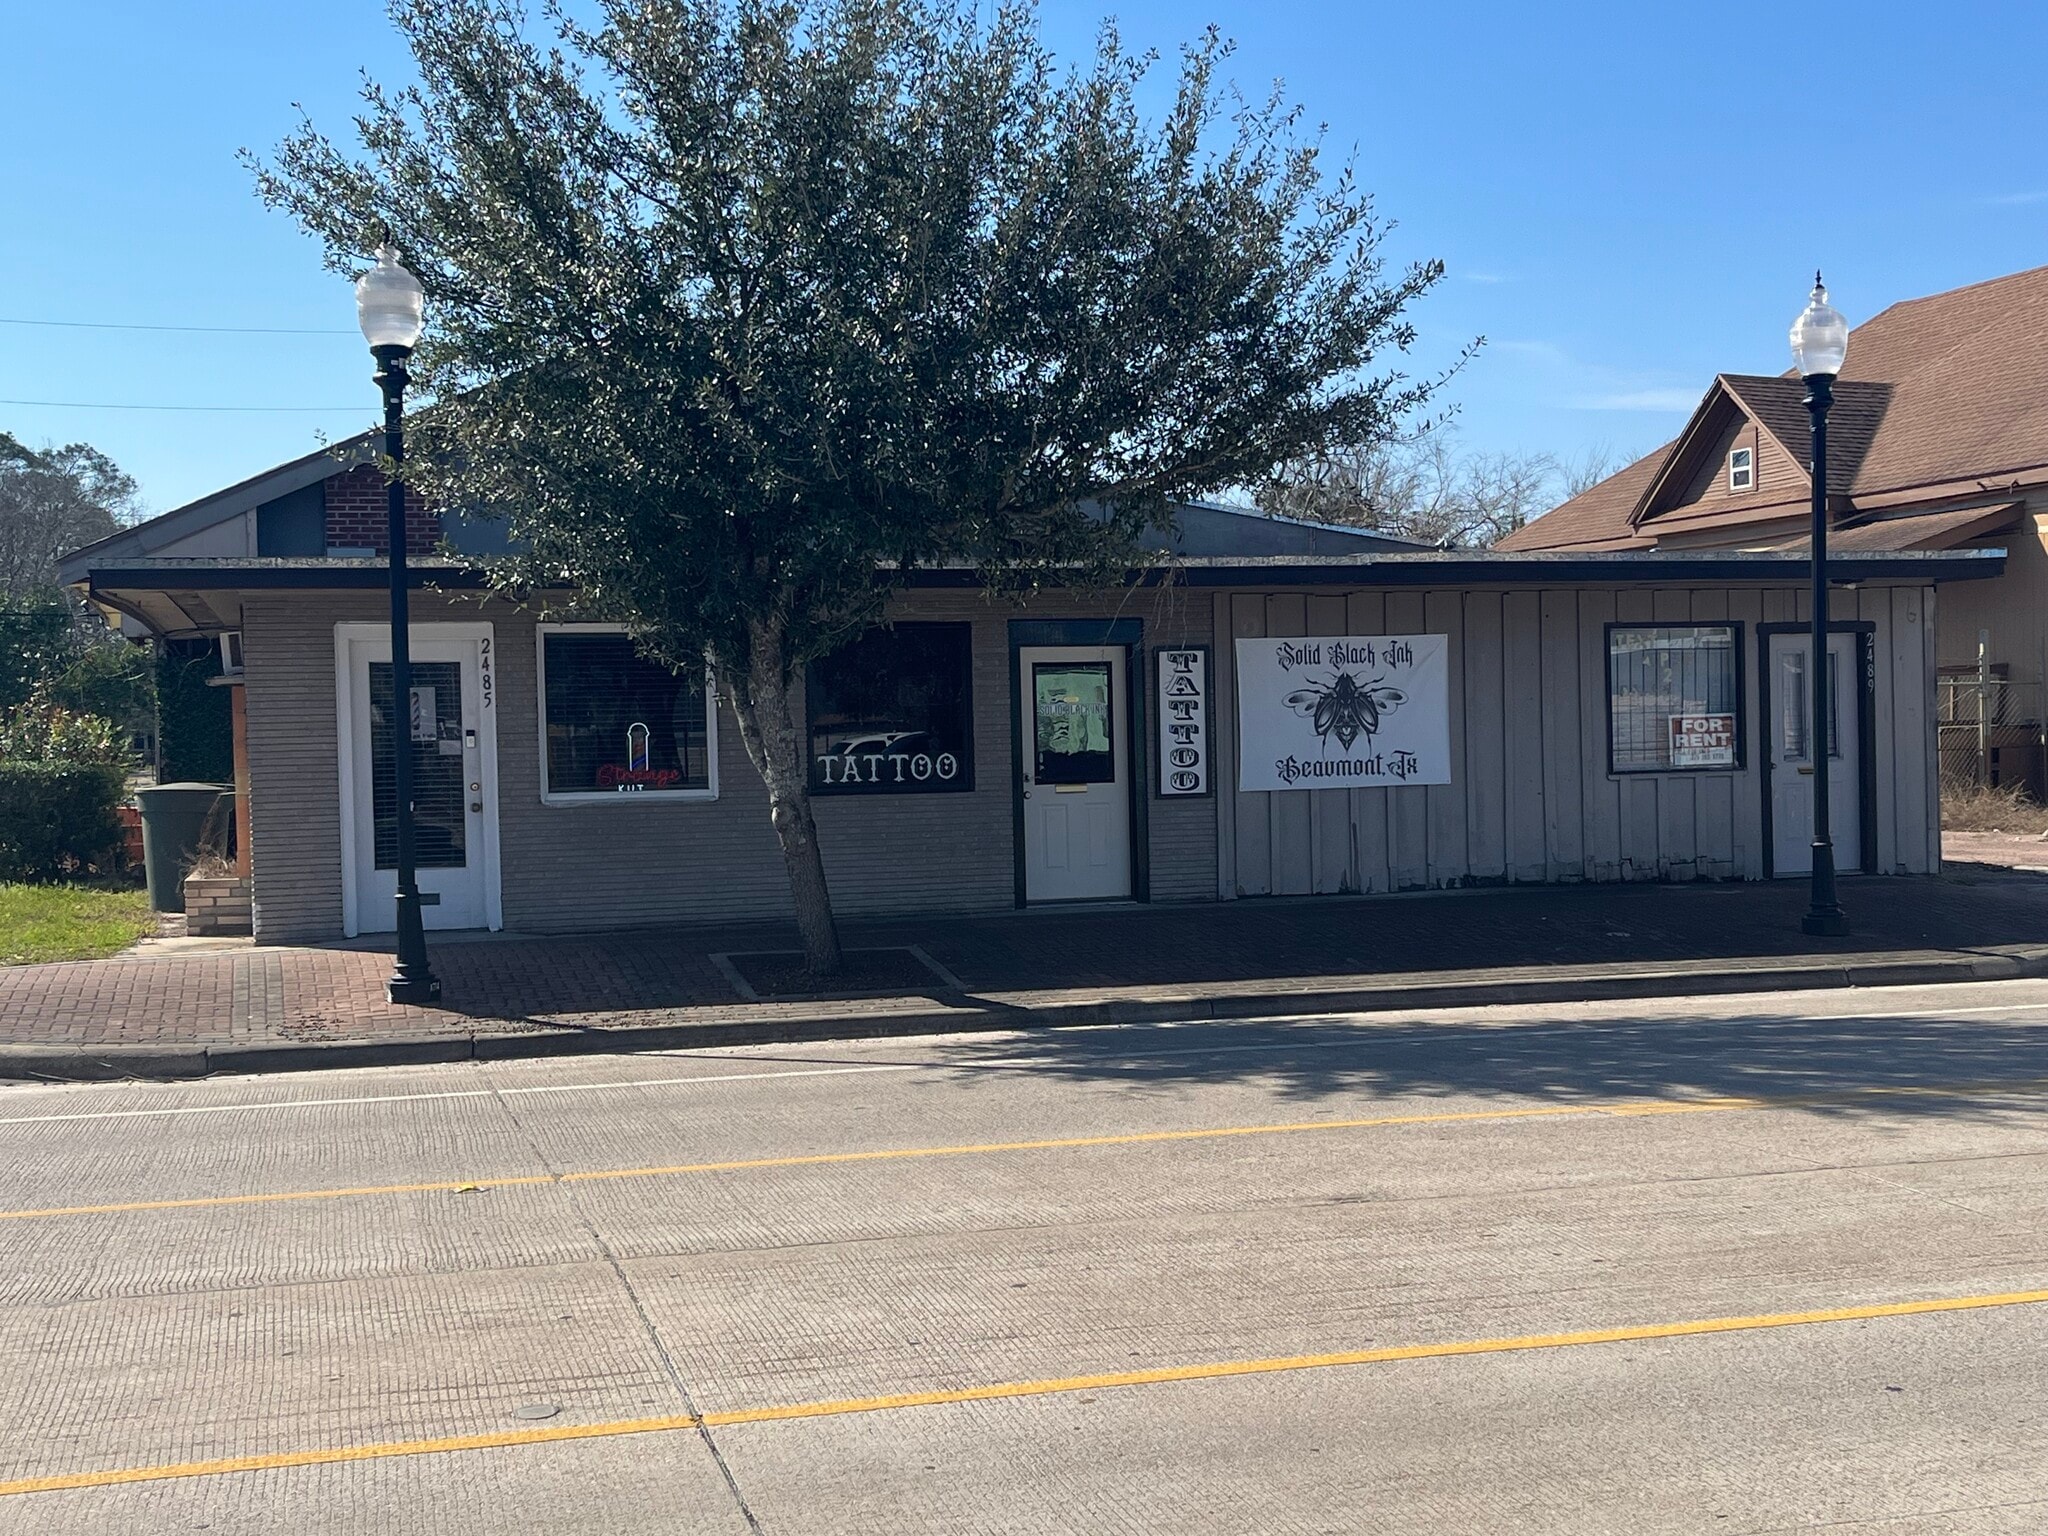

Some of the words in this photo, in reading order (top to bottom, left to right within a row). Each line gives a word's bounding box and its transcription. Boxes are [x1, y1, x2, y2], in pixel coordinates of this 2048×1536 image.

[1276, 641, 1321, 672] Solid
[1327, 641, 1376, 670] Black
[1382, 640, 1413, 669] Ink
[1866, 632, 1874, 694] 2489
[481, 638, 492, 708] 2485
[1164, 652, 1201, 791] TATTOO
[1682, 718, 1723, 733] FOR
[1675, 733, 1731, 747] RENT
[817, 752, 958, 784] TATTOO
[1386, 750, 1418, 781] Tx
